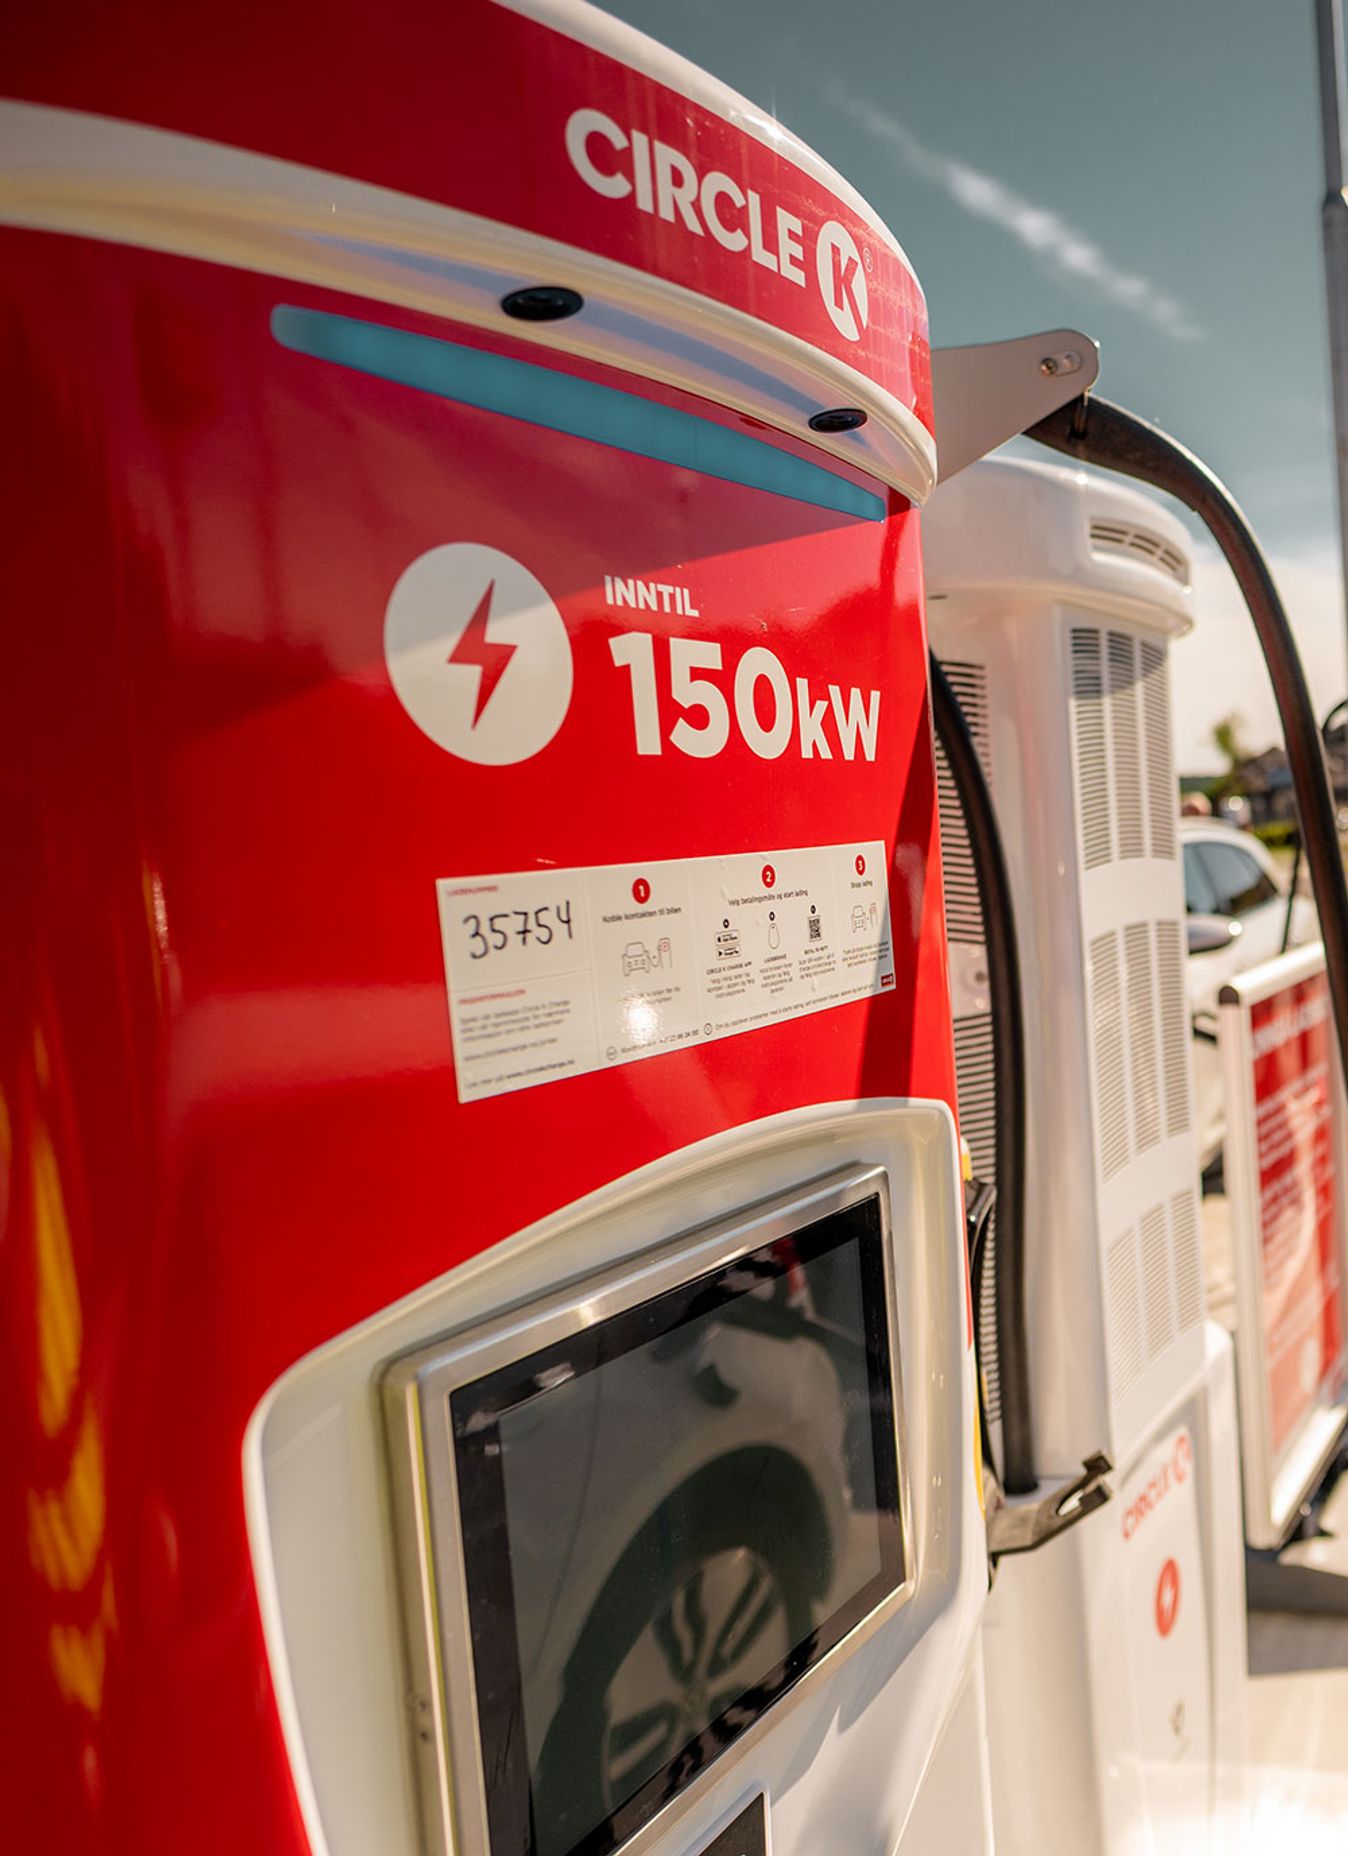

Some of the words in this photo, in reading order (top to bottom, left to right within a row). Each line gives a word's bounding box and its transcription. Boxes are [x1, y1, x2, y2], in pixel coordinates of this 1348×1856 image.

[565, 108, 805, 288] CIRCLE
[822, 228, 866, 340] K
[604, 575, 699, 617] INNTIL
[608, 631, 881, 762] 150kW
[462, 900, 573, 960] 35754
[666, 907, 681, 915] bilen
